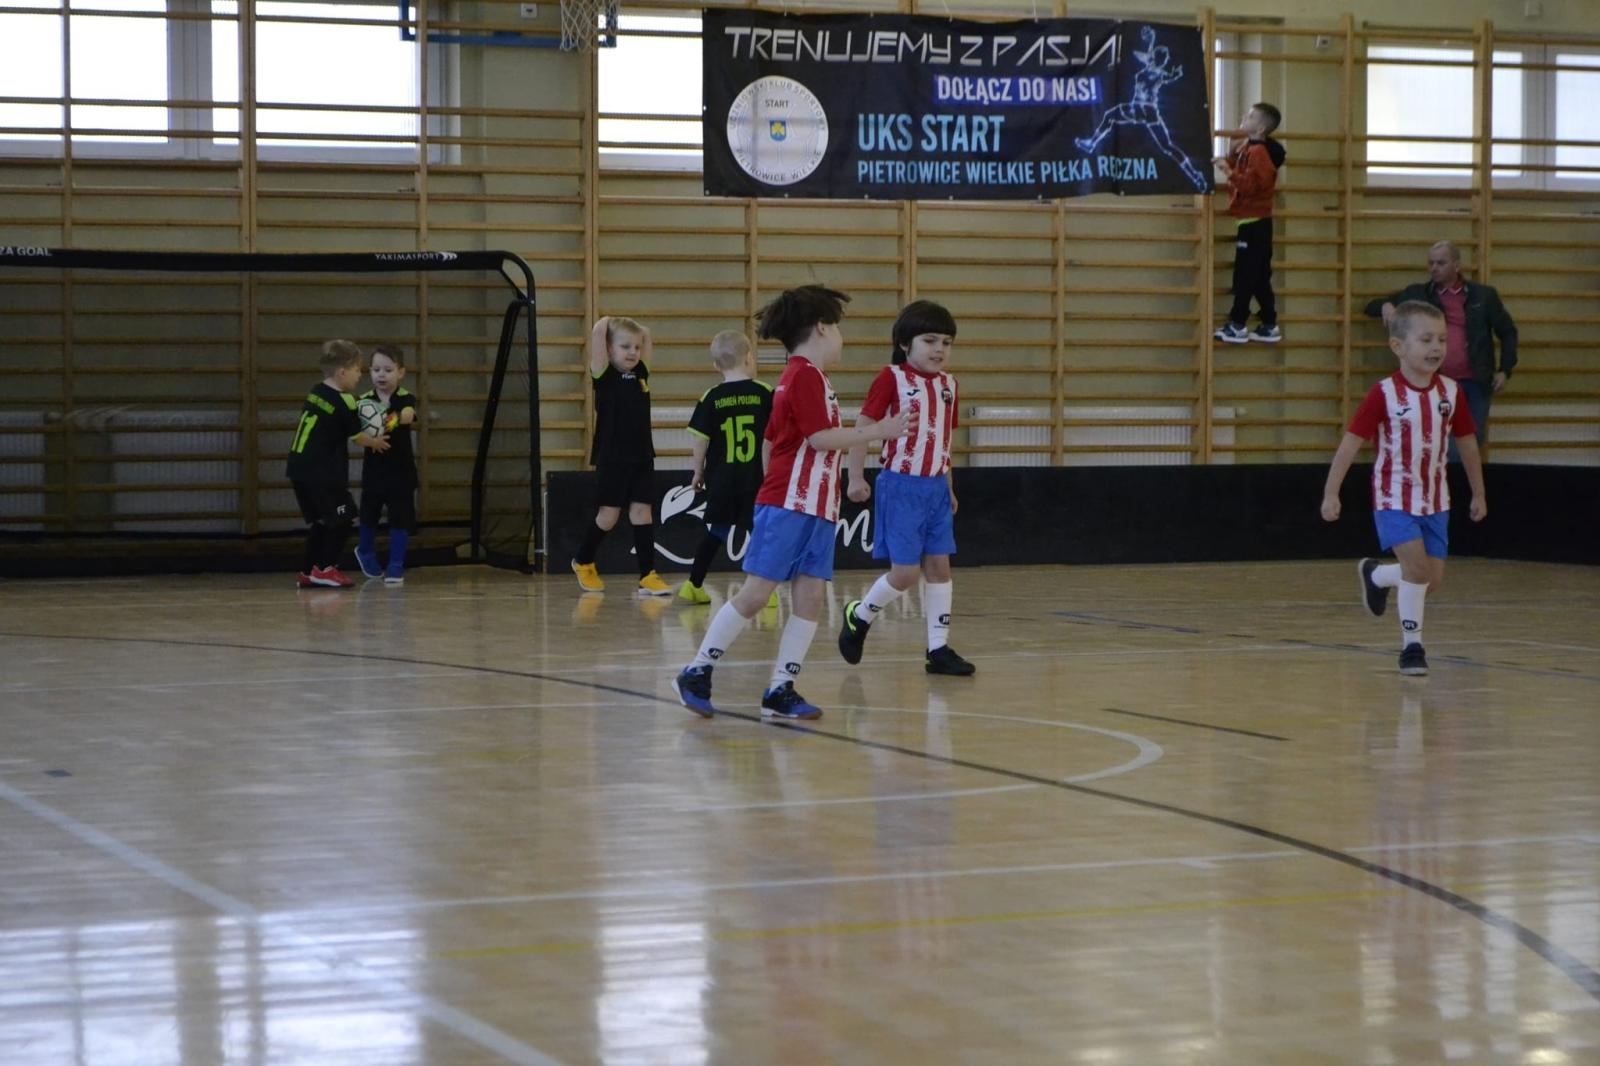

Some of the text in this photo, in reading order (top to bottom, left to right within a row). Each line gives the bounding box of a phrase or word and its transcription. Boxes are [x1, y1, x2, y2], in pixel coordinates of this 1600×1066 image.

[724, 26, 952, 65] TRENUJEMY
[959, 35, 984, 66] Z
[765, 100, 789, 109] START
[937, 76, 1098, 105] DOŁĄCZ DO NAS!
[858, 113, 1005, 153] UKS START
[857, 155, 1158, 185] PIETROWICE WIELKIE PIŁKA RĘCZNA
[16, 247, 53, 257] GOAL
[375, 253, 440, 261] YAKIMASPORT
[720, 415, 756, 464] 15
